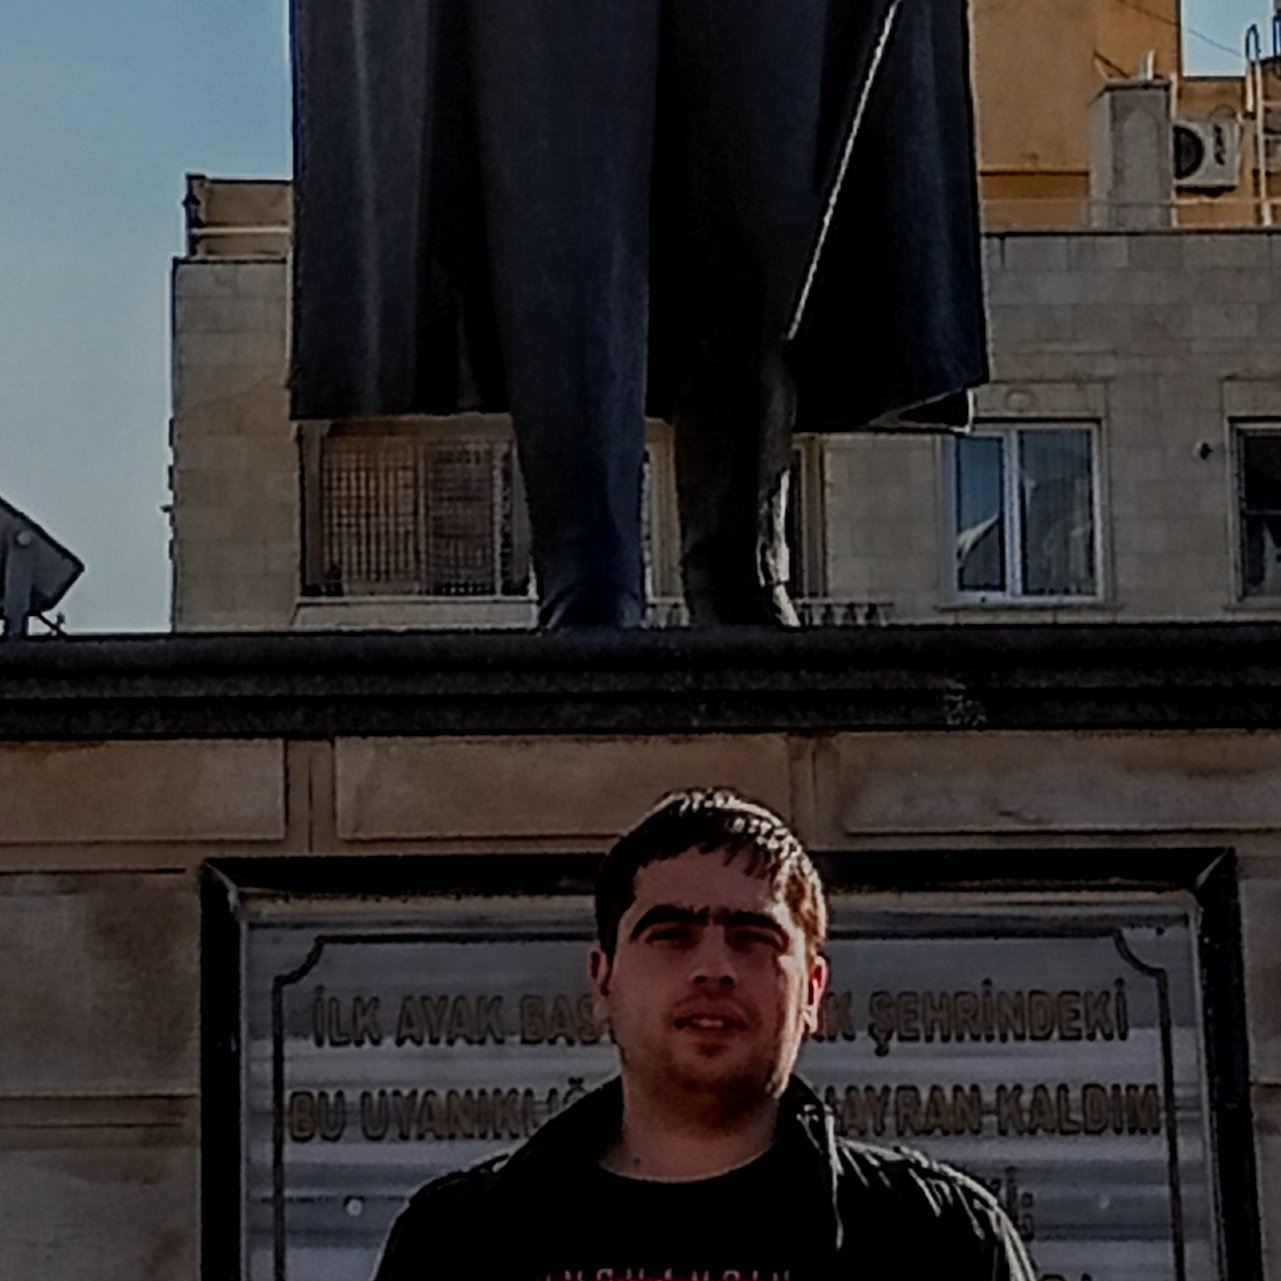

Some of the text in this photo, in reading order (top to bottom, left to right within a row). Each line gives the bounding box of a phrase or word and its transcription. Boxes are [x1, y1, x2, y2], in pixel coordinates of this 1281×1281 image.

[313, 986, 382, 1046] İLK
[395, 995, 505, 1046] AYAK
[868, 978, 1129, 1057] ŞEHRİNDEKİ
[289, 1090, 347, 1142] BU
[996, 1083, 1162, 1136] KALDIM
